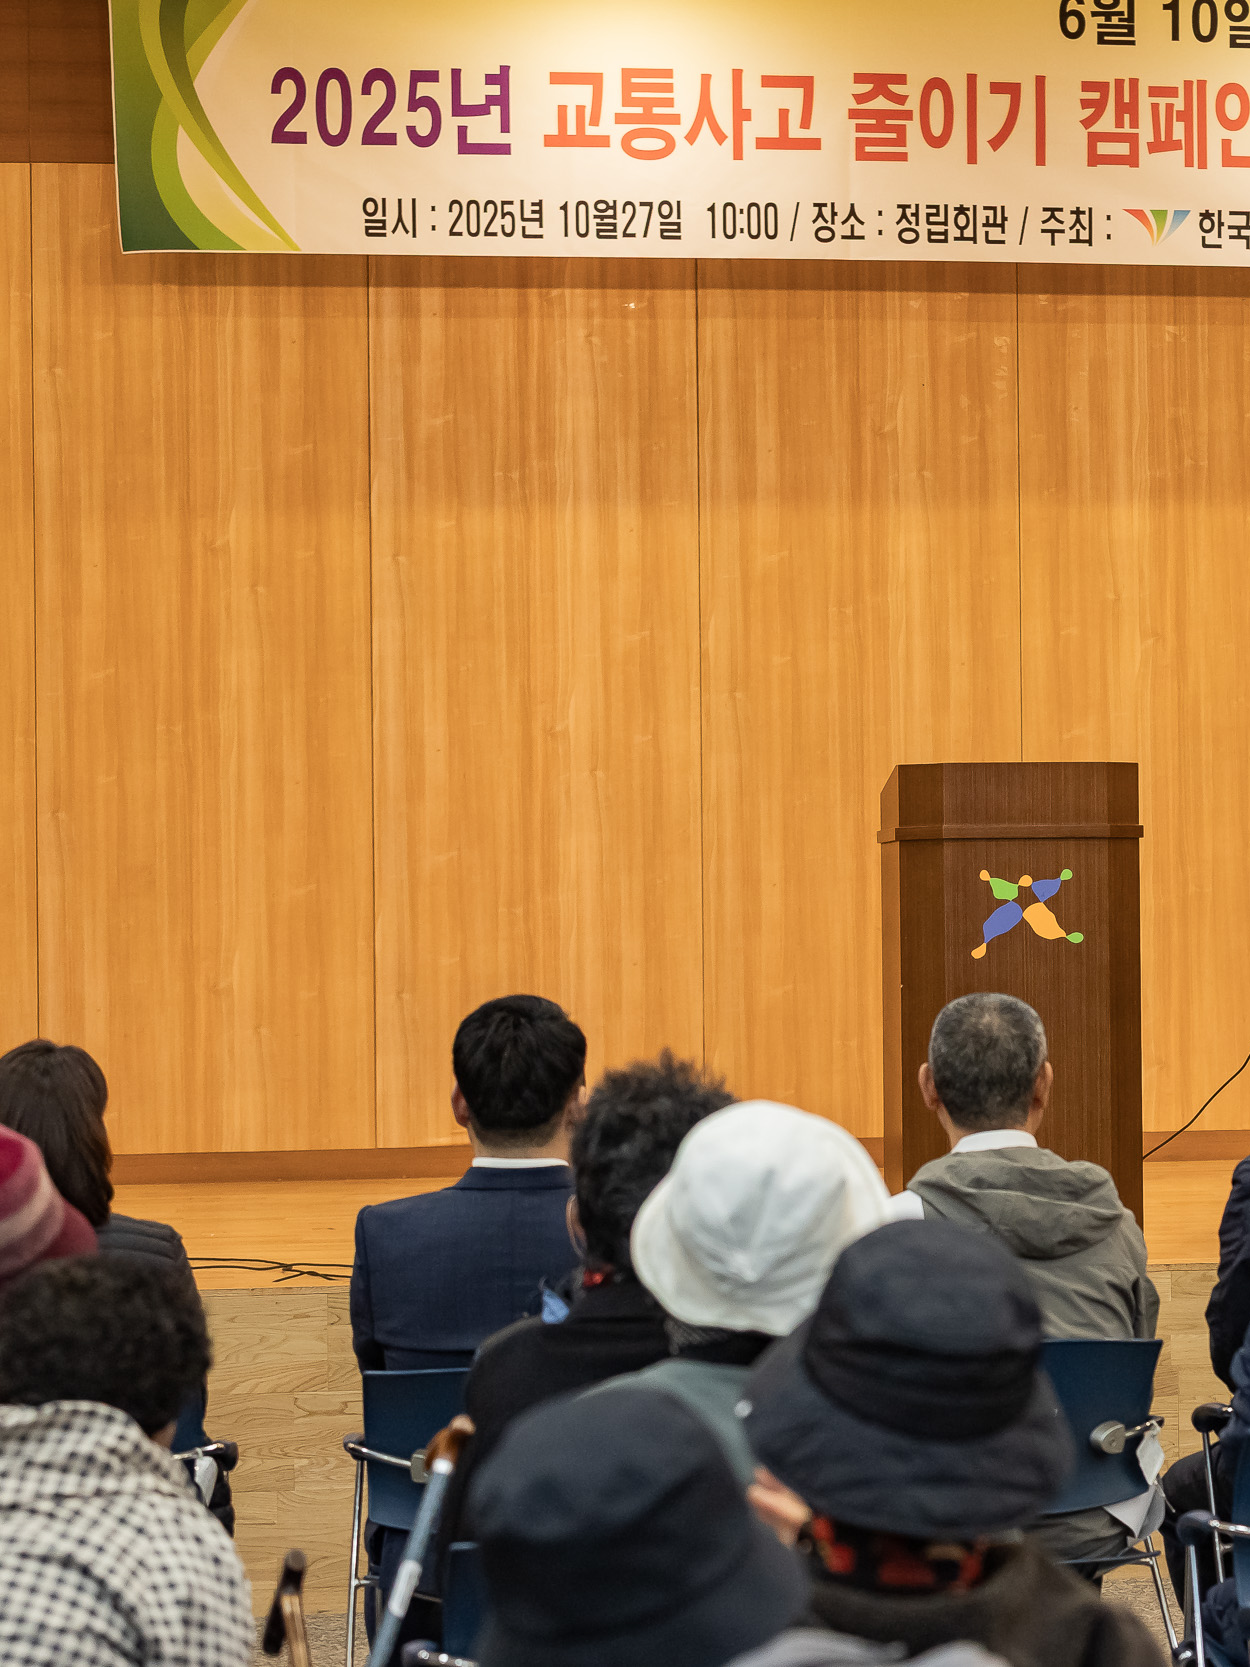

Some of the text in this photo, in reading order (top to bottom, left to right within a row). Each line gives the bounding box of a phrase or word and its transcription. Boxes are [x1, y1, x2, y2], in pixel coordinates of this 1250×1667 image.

[1058, 0, 1137, 47] 6월
[270, 64, 512, 156] 2025년
[543, 67, 822, 161] 교통사고
[847, 72, 1047, 167] 줄이기
[362, 196, 417, 239] 일시
[448, 198, 544, 240] 2025년
[559, 199, 682, 241] 10월27일
[706, 201, 779, 241] 10:00
[812, 201, 866, 244] 장소
[896, 203, 1009, 245] 정립회관
[1040, 206, 1093, 247] 주최
